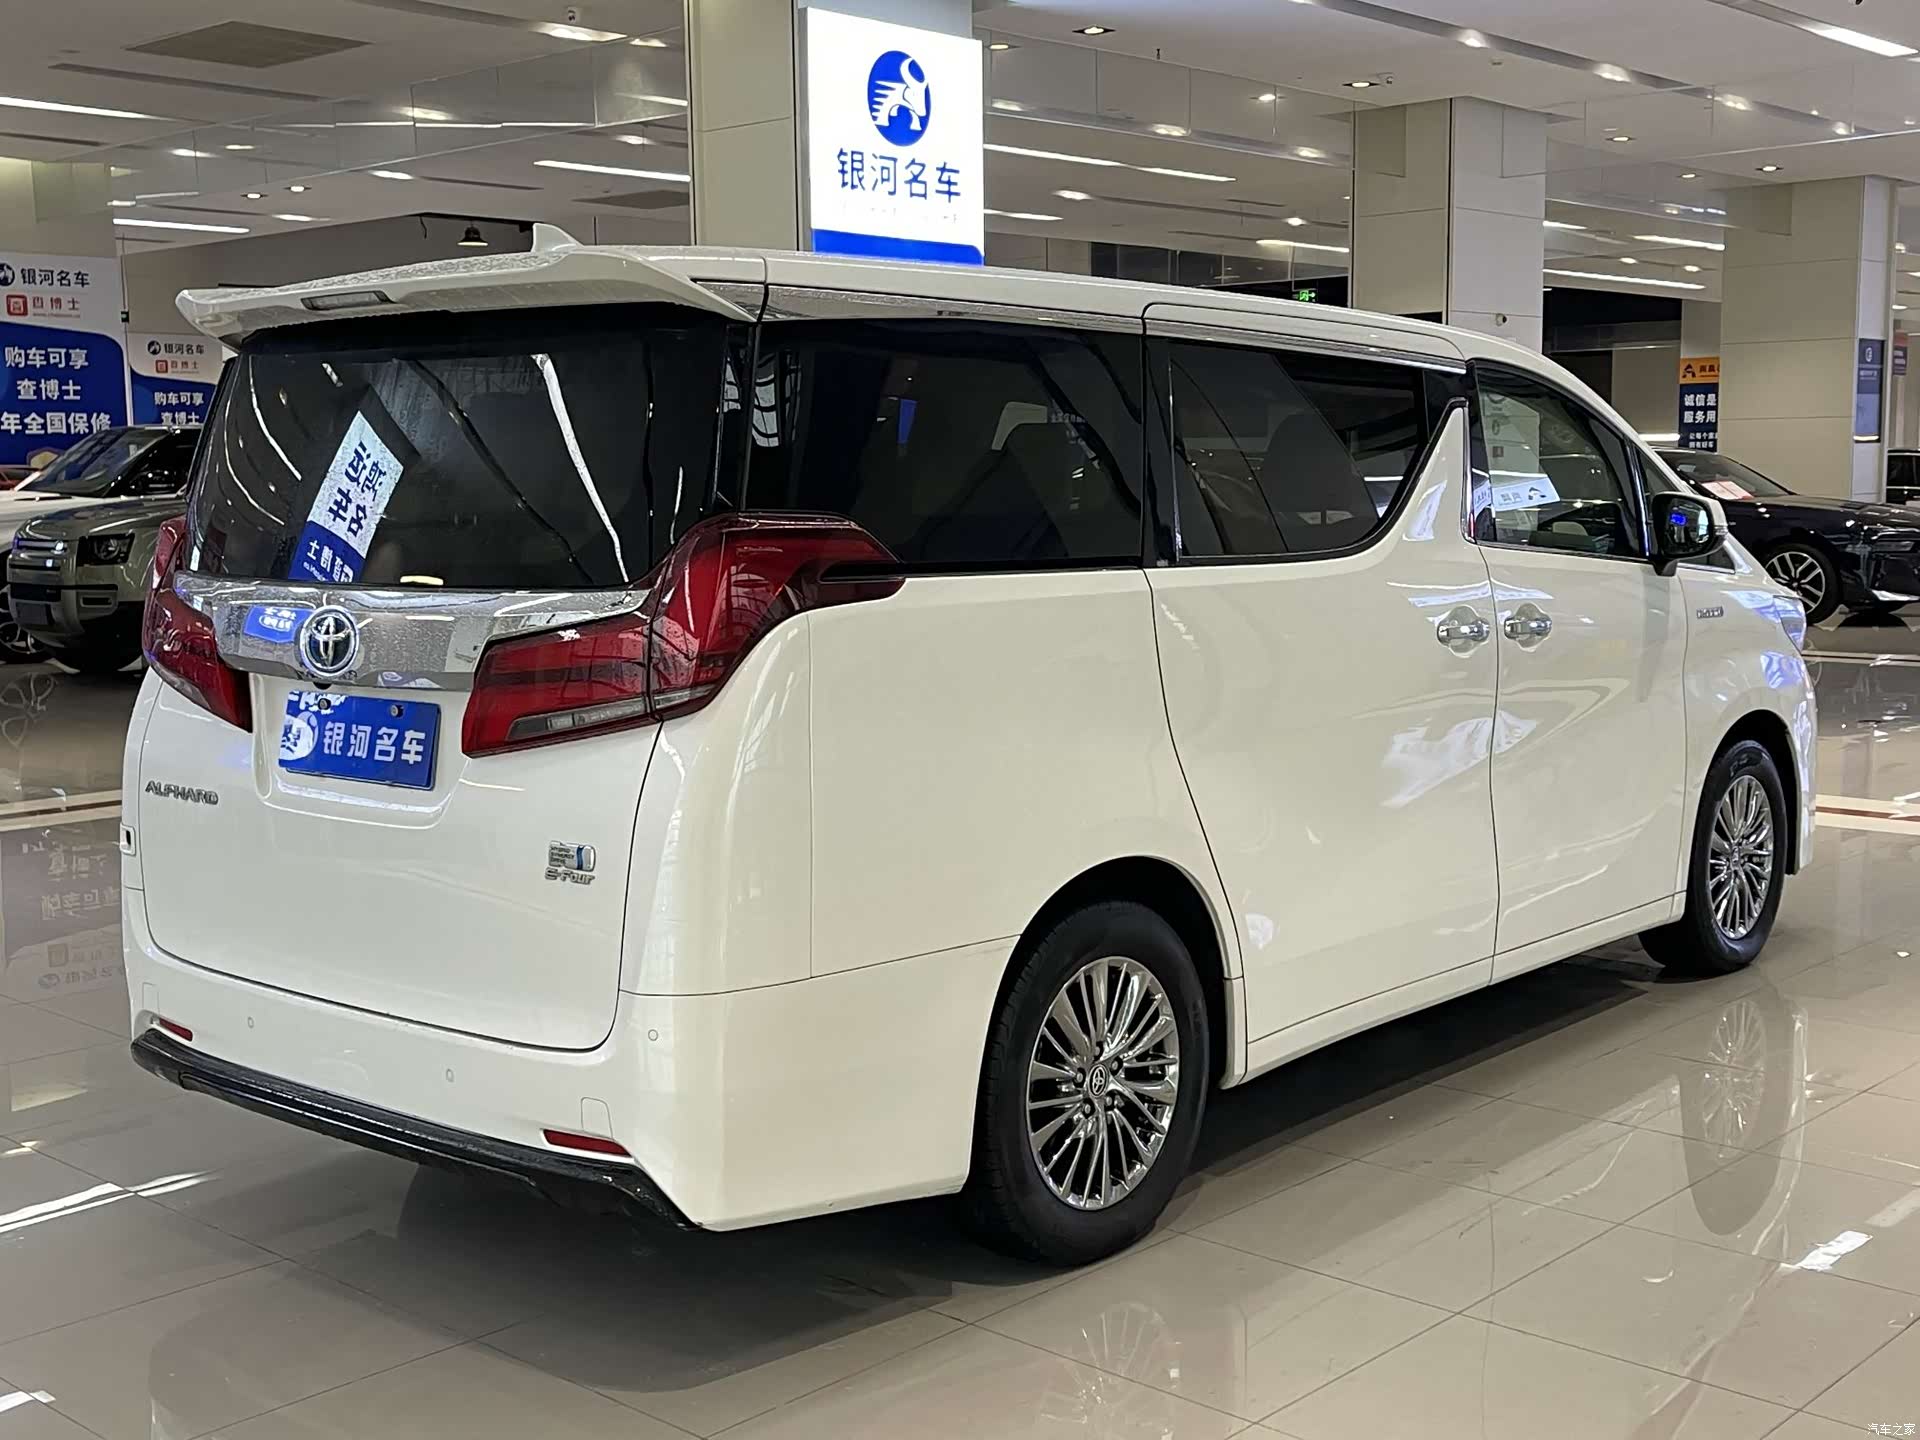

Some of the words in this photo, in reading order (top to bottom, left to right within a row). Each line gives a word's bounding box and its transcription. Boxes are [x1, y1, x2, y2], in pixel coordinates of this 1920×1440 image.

[837, 147, 961, 203] 银河名车
[20, 267, 90, 288] 银河名车
[4, 346, 89, 370] 购车可享
[164, 343, 205, 355] 银河名车
[16, 378, 82, 400] 查博士
[154, 391, 205, 406] 购车可享
[0, 411, 112, 435] 年全国保修
[161, 410, 200, 426] 查博士
[322, 720, 427, 765] 银河名车
[144, 780, 219, 806] ALPHARD
